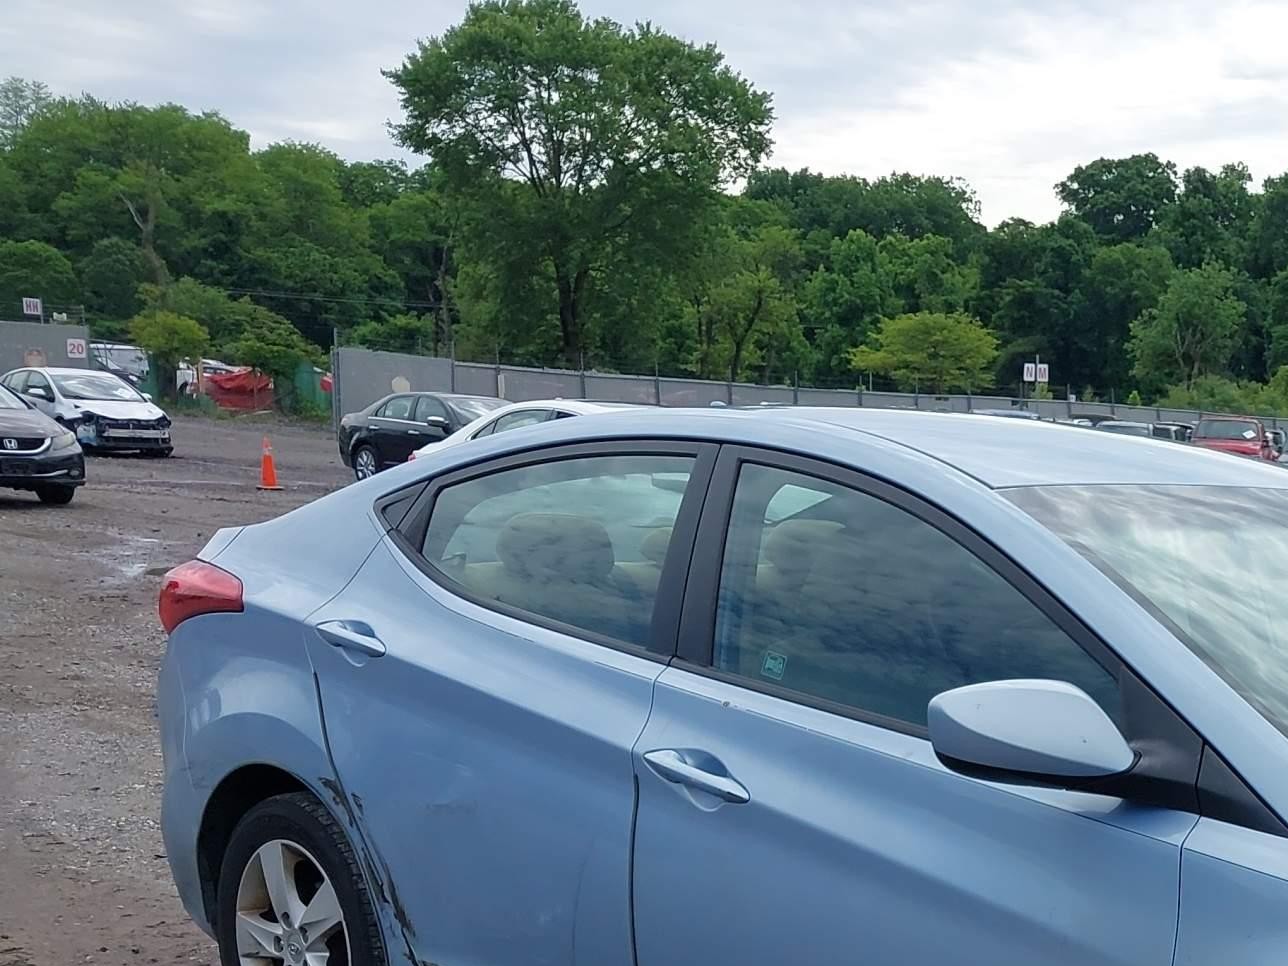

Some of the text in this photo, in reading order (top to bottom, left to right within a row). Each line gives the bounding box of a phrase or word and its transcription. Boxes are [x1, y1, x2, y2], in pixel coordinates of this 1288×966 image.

[69, 343, 84, 355] 20
[1026, 366, 1033, 378] N
[1038, 367, 1047, 379] M
